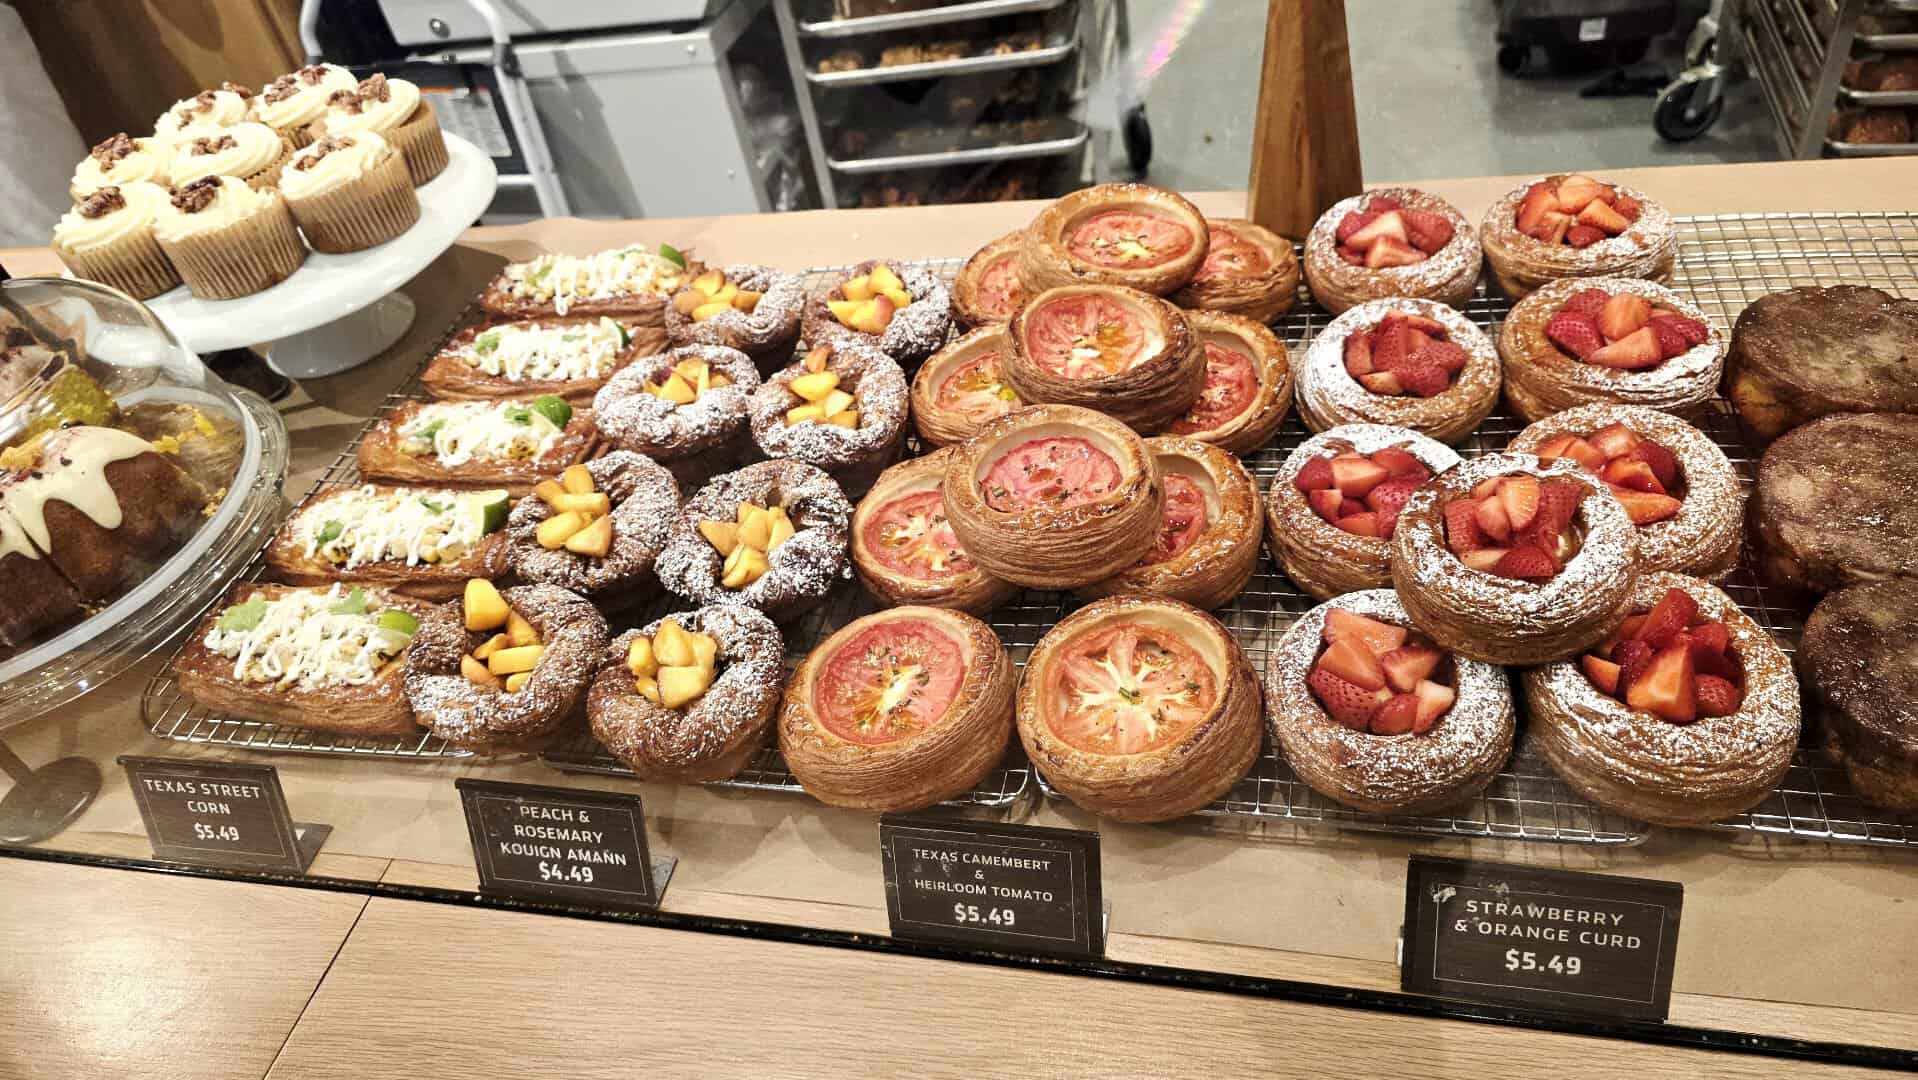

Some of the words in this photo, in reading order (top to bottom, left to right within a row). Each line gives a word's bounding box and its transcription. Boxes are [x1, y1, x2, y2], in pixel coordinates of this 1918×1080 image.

[144, 779, 196, 794] TEXAS
[201, 783, 260, 798] STREET
[187, 800, 231, 815] CORN
[519, 806, 573, 822] PEACH
[579, 810, 591, 823] &
[194, 822, 240, 841] $5.49
[514, 824, 604, 844] ROSEMARY
[500, 842, 561, 860] KOUIGN
[912, 848, 958, 863] TEXAS
[962, 853, 1051, 871] CAMEMBERT
[538, 860, 594, 883] $4.49
[974, 869, 985, 880] &
[914, 879, 987, 896] HEIRLOOM
[991, 886, 1053, 902] TOMATO
[954, 902, 1016, 925] $5.49
[1466, 899, 1625, 926] STRAWBERRY
[1454, 919, 1468, 933] &
[1478, 921, 1570, 942] ORANGE
[1579, 931, 1642, 949] CURD
[1505, 948, 1582, 975] $5.49
